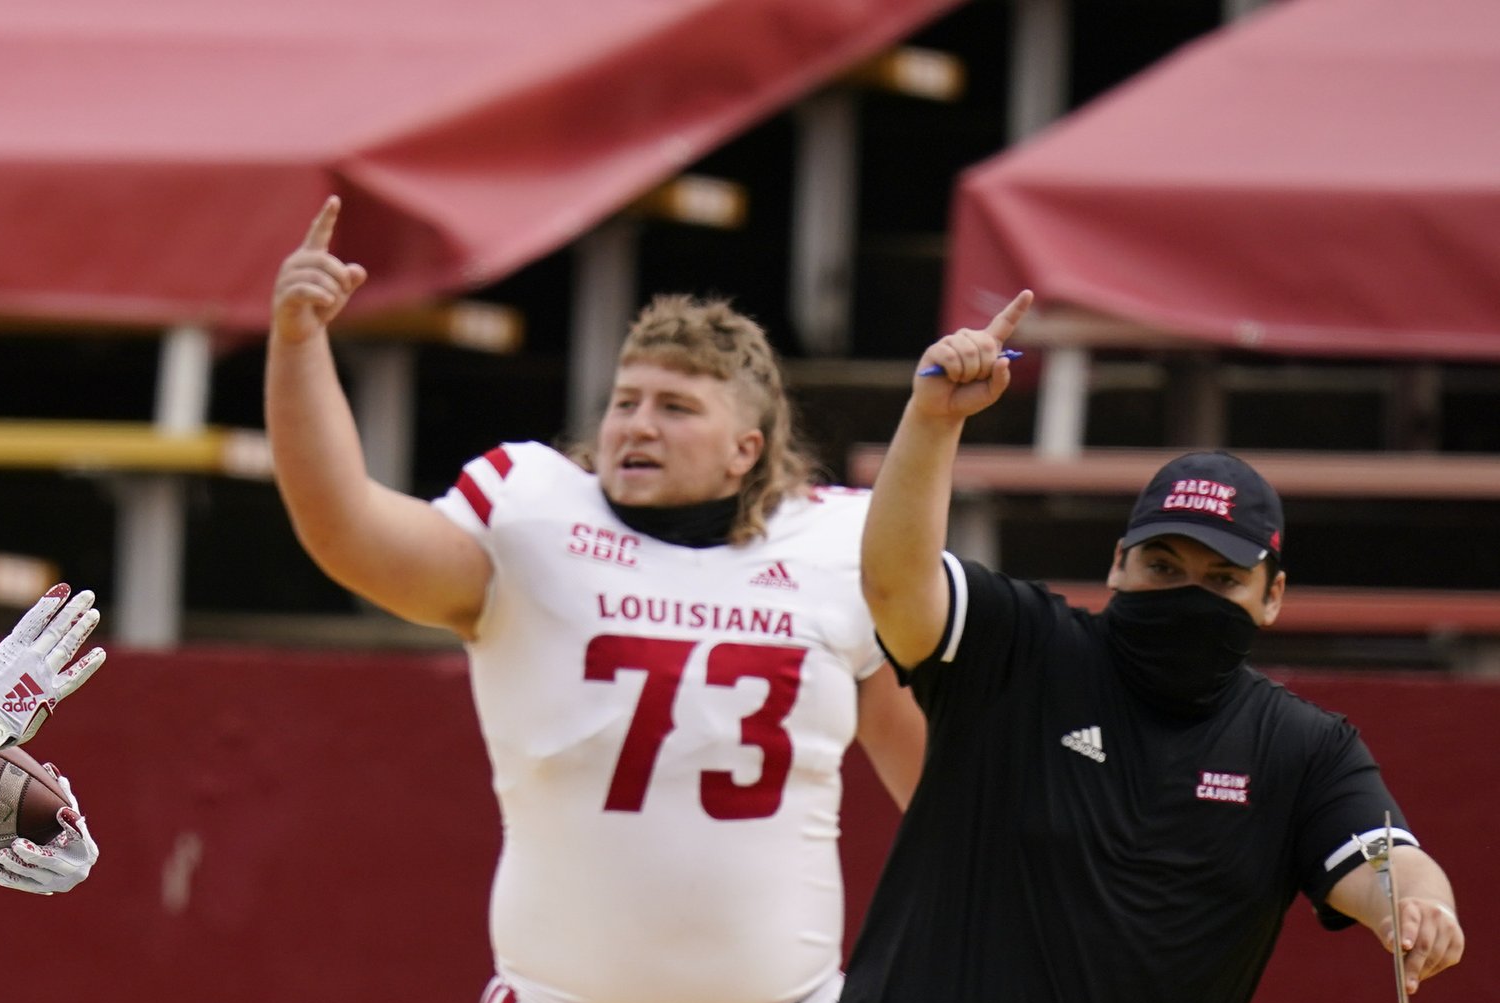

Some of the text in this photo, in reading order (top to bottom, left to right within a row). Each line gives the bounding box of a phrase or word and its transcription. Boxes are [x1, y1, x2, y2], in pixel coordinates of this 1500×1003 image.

[1163, 494, 1231, 516] CAJUNS
[567, 523, 642, 567] SBC
[598, 593, 795, 637] LOUISIANA
[2, 697, 56, 713] adids
[584, 634, 810, 821] 73
